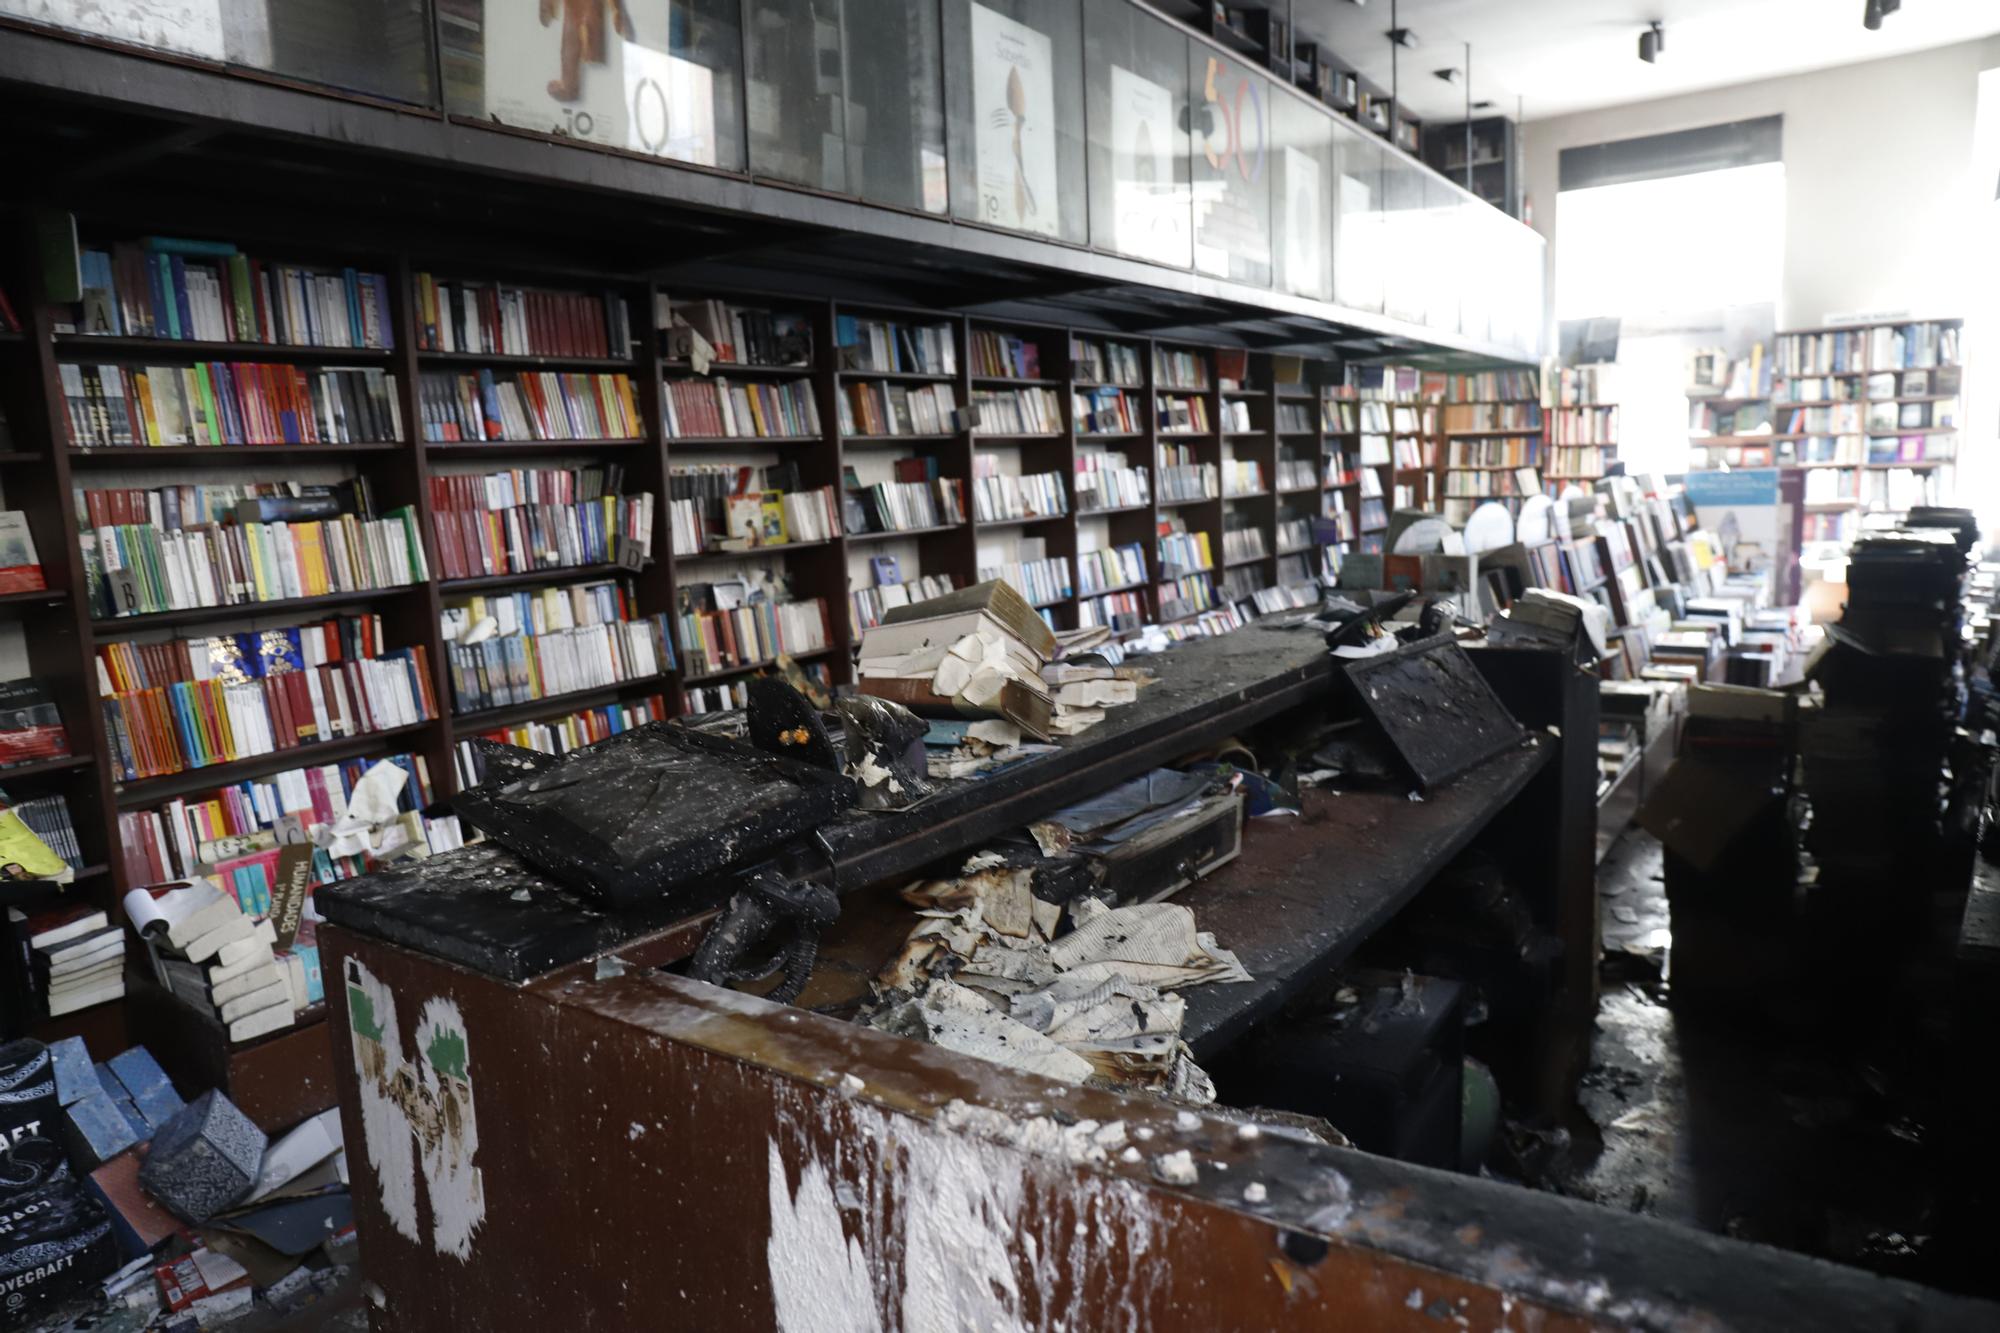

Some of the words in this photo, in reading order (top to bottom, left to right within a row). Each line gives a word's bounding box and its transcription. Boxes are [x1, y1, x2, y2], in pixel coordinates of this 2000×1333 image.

[95, 303, 109, 331] A
[676, 336, 690, 355] G
[627, 548, 641, 568] D
[122, 582, 136, 609] B
[692, 658, 705, 676] H
[287, 827, 298, 845] C
[280, 860, 309, 934] HUMANIDADES
[0, 1255, 74, 1296] OVECRAFT
